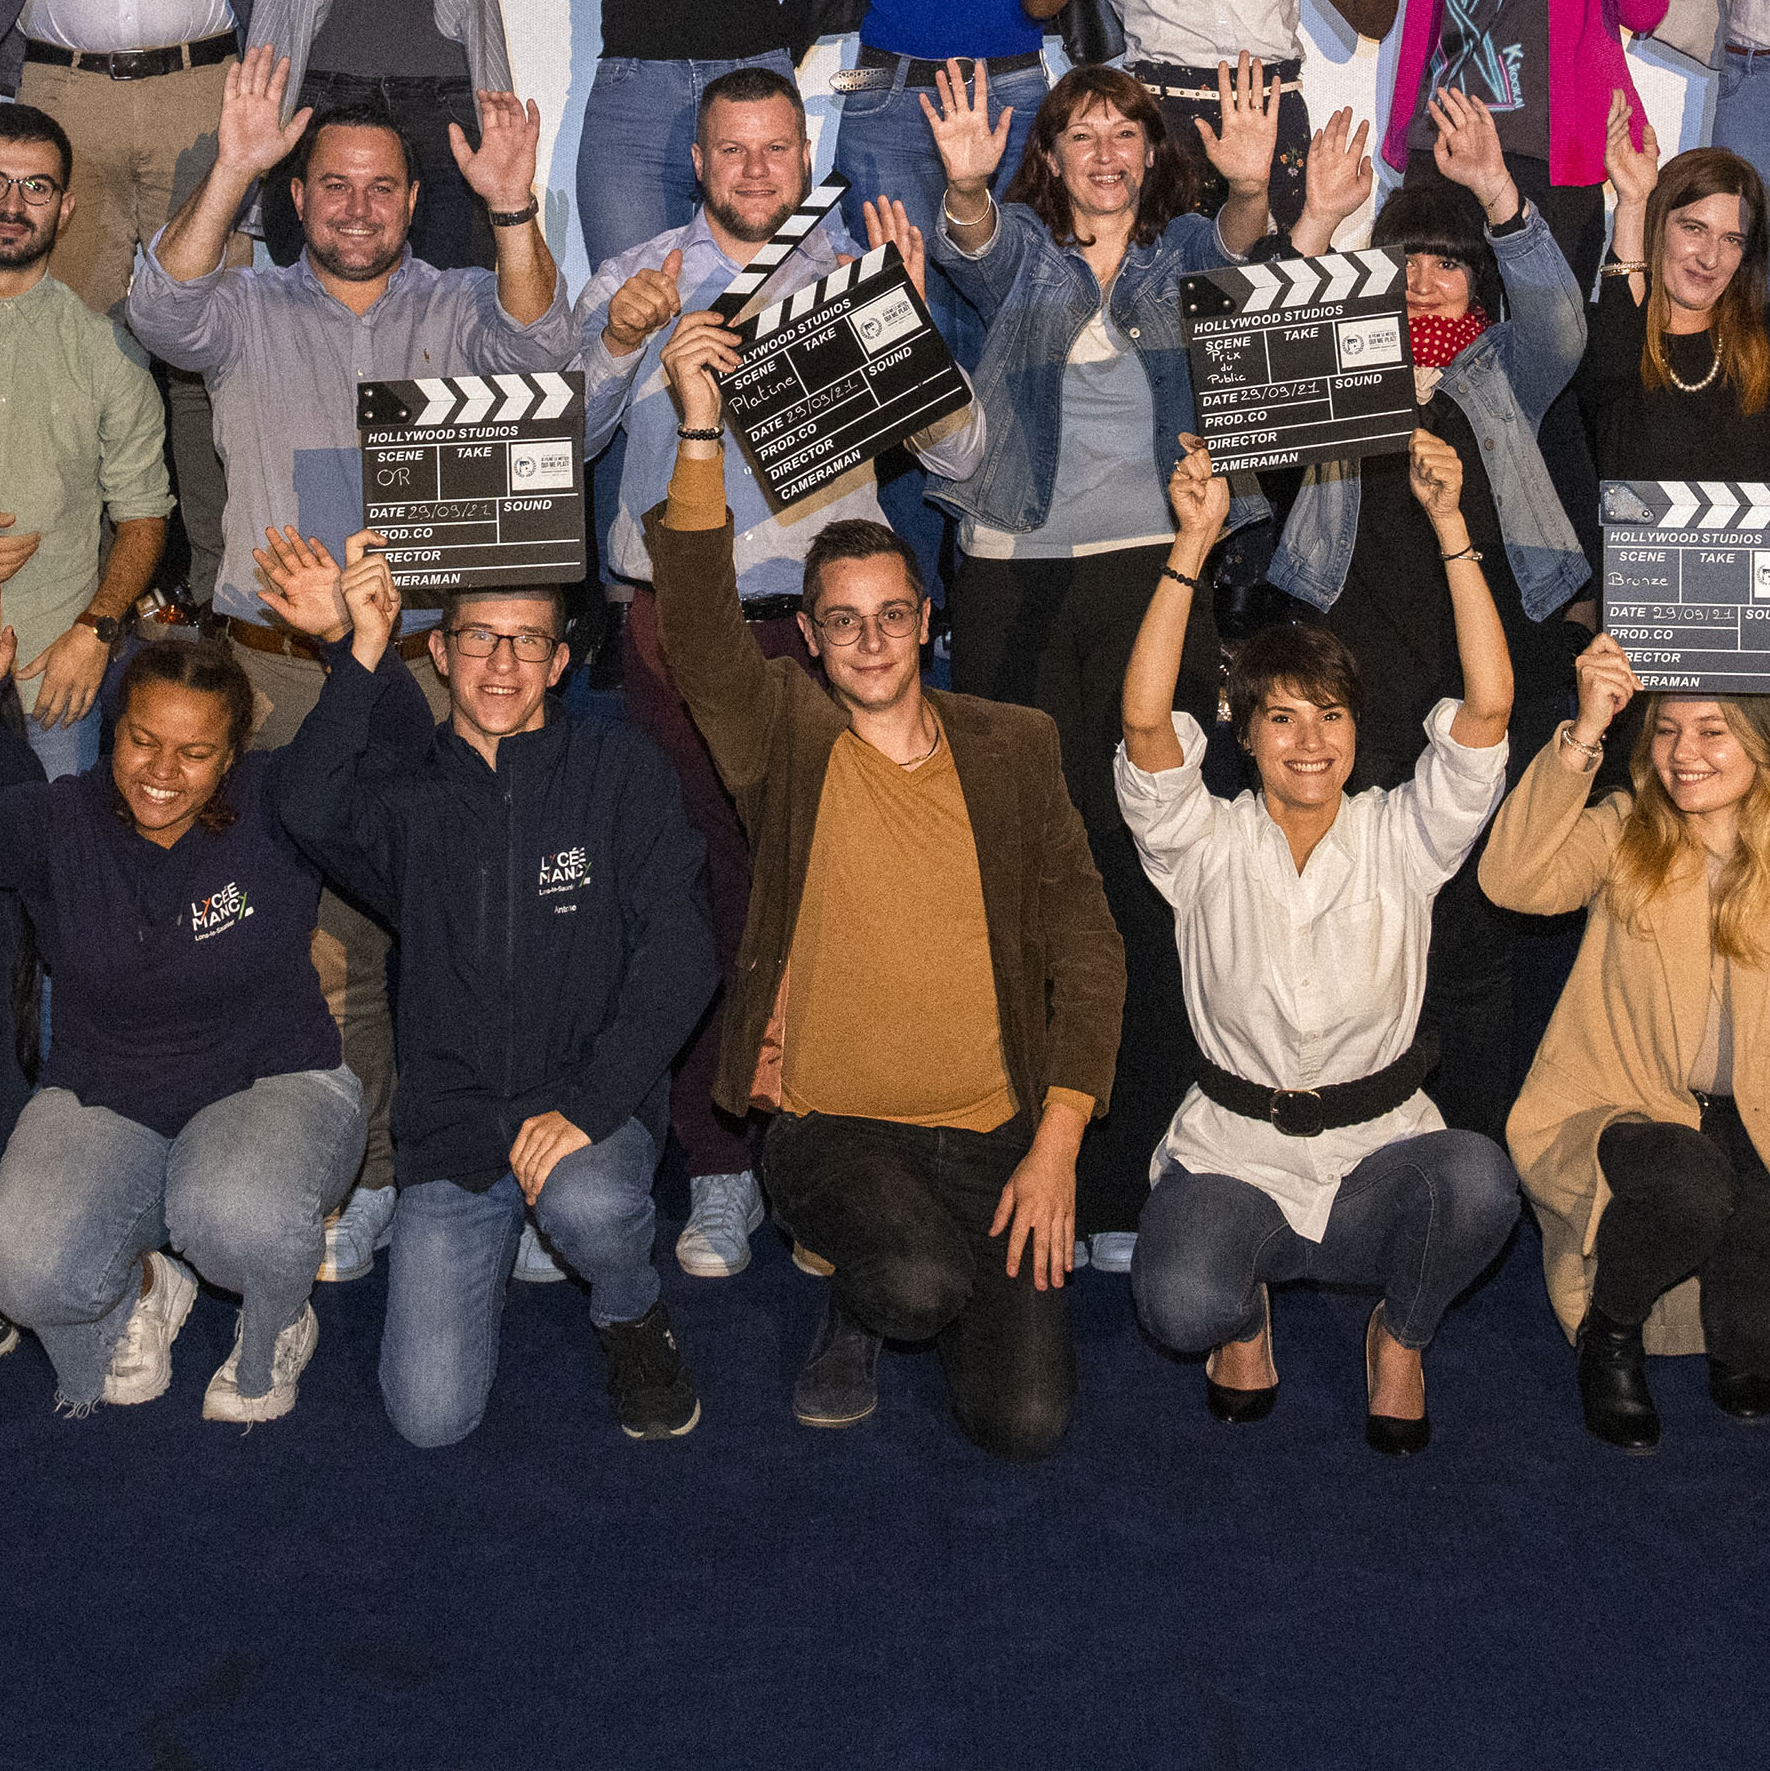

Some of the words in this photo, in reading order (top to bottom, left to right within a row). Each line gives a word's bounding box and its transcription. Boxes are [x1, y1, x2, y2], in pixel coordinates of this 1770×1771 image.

[797, 297, 852, 335] STUDIOS
[1194, 313, 1281, 334] HOLLYWOOD
[1284, 305, 1344, 322] STUDIOS
[803, 327, 837, 353] TAKE
[1205, 336, 1251, 351] SCENE
[1284, 328, 1319, 341] TAKE
[868, 346, 913, 377] SOUND
[1207, 350, 1241, 363] Prix
[734, 360, 777, 390] SCENE
[1221, 363, 1233, 372] du
[1207, 373, 1246, 385] Public
[1335, 374, 1383, 389] SOUND
[729, 374, 797, 415] Platine
[1203, 393, 1238, 406] DATE
[1240, 381, 1320, 402] 29/09/21
[786, 378, 859, 425] 29/09/21
[1205, 410, 1268, 428] PROD.CO
[368, 429, 456, 444] HOLLYWOOD
[458, 425, 519, 439] STUDIOS
[750, 417, 784, 443] DATE
[760, 423, 817, 461] PROD.CO
[1207, 432, 1277, 450] DIRECTOR
[377, 450, 424, 462] SCENE
[456, 446, 492, 458] TAKE
[770, 438, 834, 481] DIRECTOR
[1211, 452, 1299, 473] CAMERAMAN
[780, 449, 862, 501] CAMERAMAN
[369, 507, 406, 519] DATE
[407, 503, 491, 520] 29/09/21
[503, 499, 552, 512] SOUND
[374, 527, 433, 540] ROD.CO
[1610, 531, 1699, 544] HOLLYWOOD
[1702, 533, 1763, 545] STUDIOS
[385, 550, 441, 563] RECTOR
[1619, 551, 1666, 563] SCENE
[1700, 553, 1735, 564] TAKE
[392, 573, 461, 587] MERAMAN
[1607, 571, 1669, 587] Bronze
[1610, 606, 1646, 618] DATE
[1652, 606, 1736, 621] 29/09/21
[1625, 651, 1681, 663] RECTOR
[1637, 675, 1700, 688] ERAMAN
[191, 881, 240, 922] LYCÉE
[192, 892, 247, 931] MANCY
